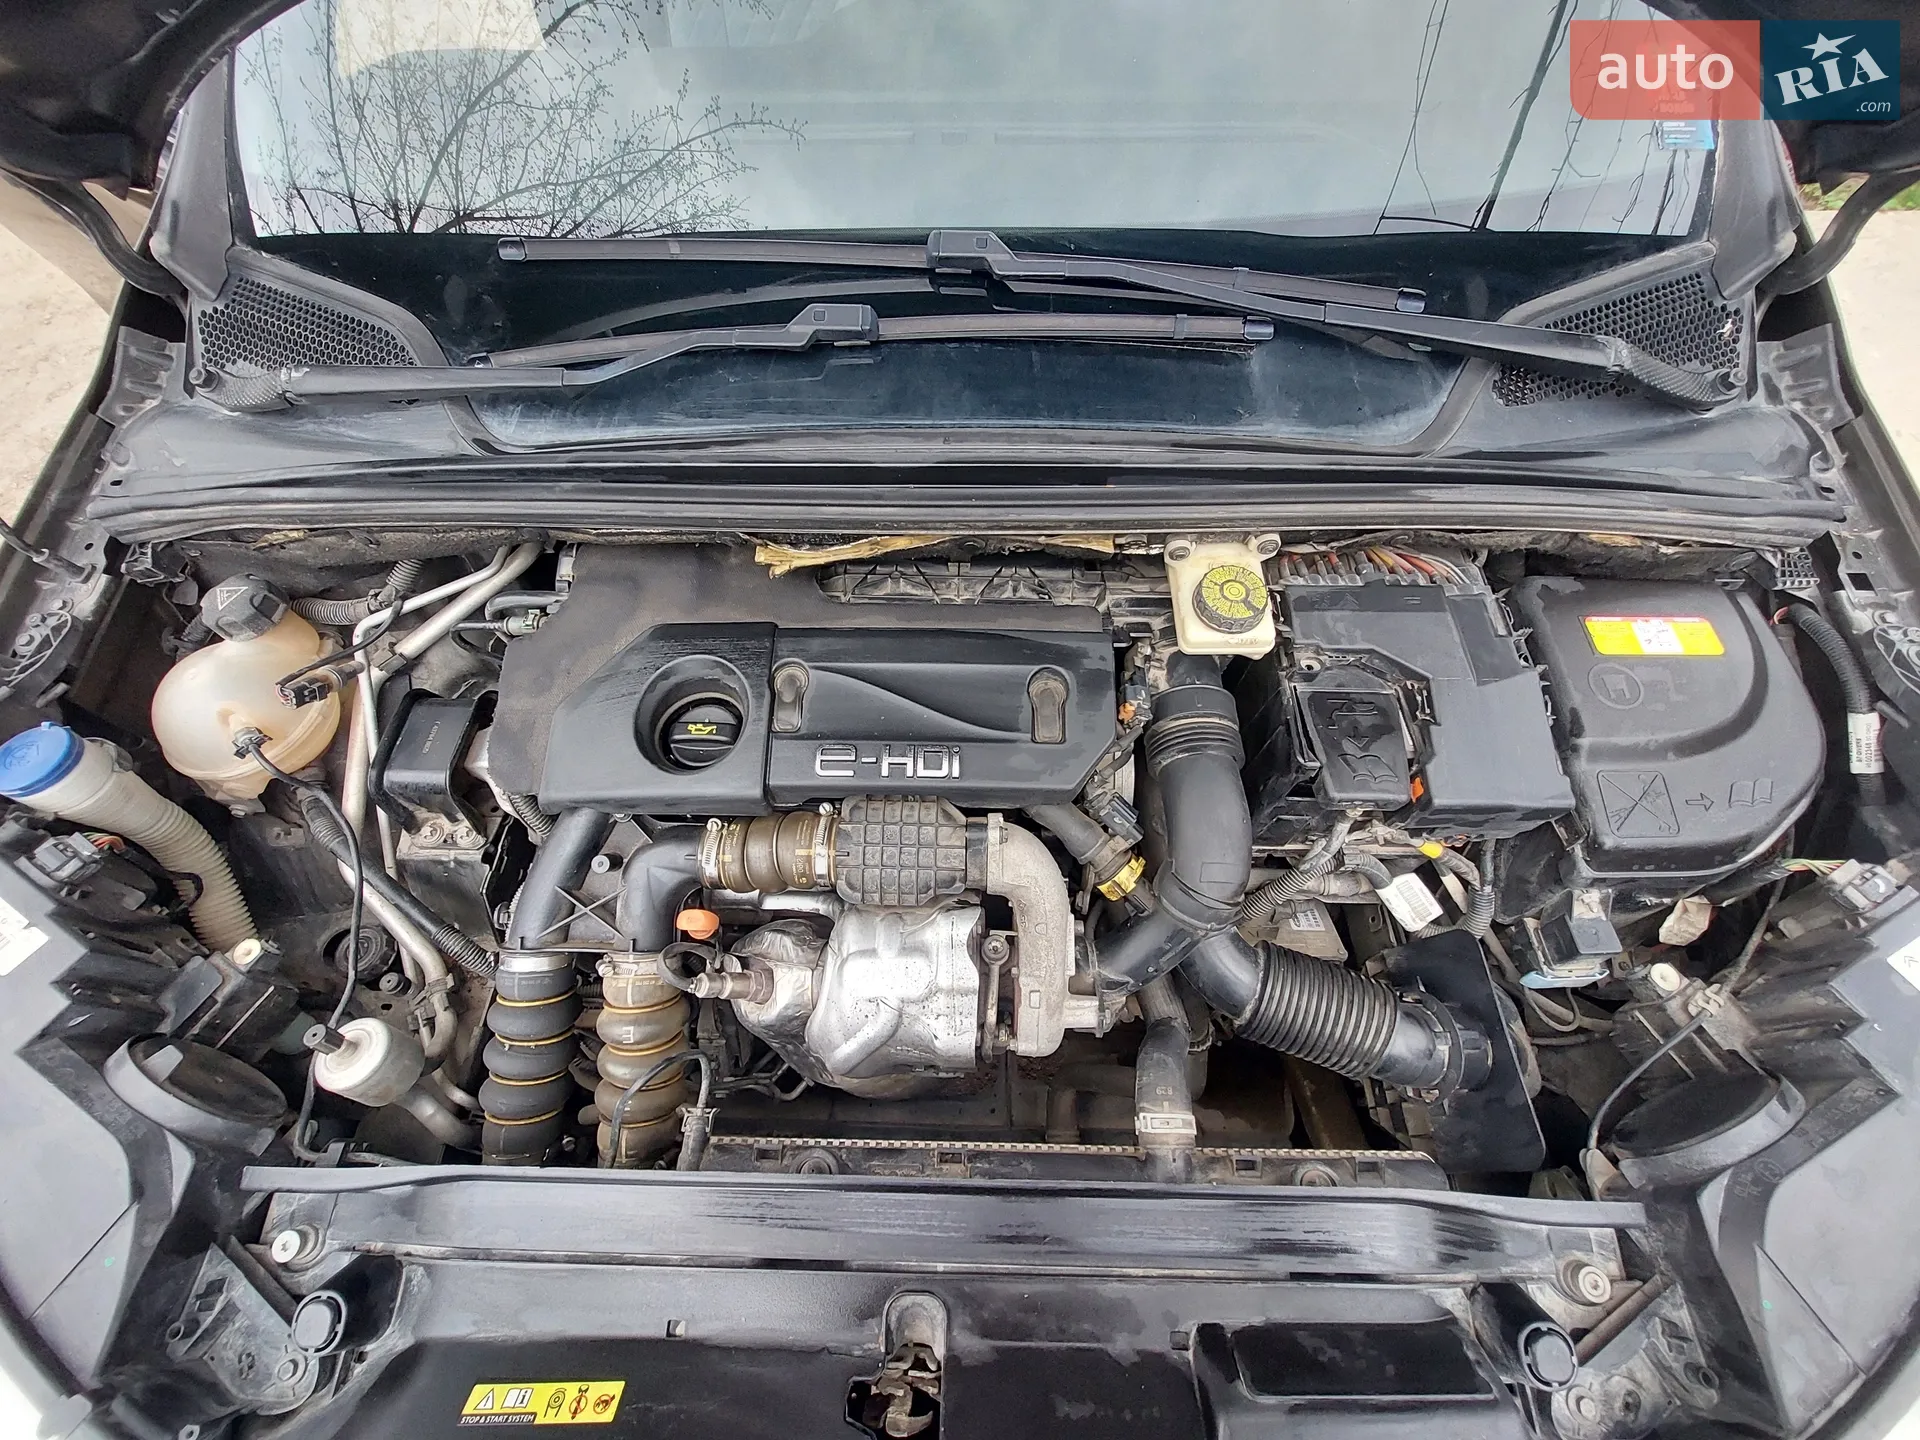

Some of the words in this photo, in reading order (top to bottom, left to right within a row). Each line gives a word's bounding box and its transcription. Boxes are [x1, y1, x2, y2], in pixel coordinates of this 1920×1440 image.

[815, 744, 960, 780] e-HDi
[461, 1416, 480, 1424] STOP
[485, 1415, 508, 1423] START
[508, 1414, 534, 1423] SYSTEM
